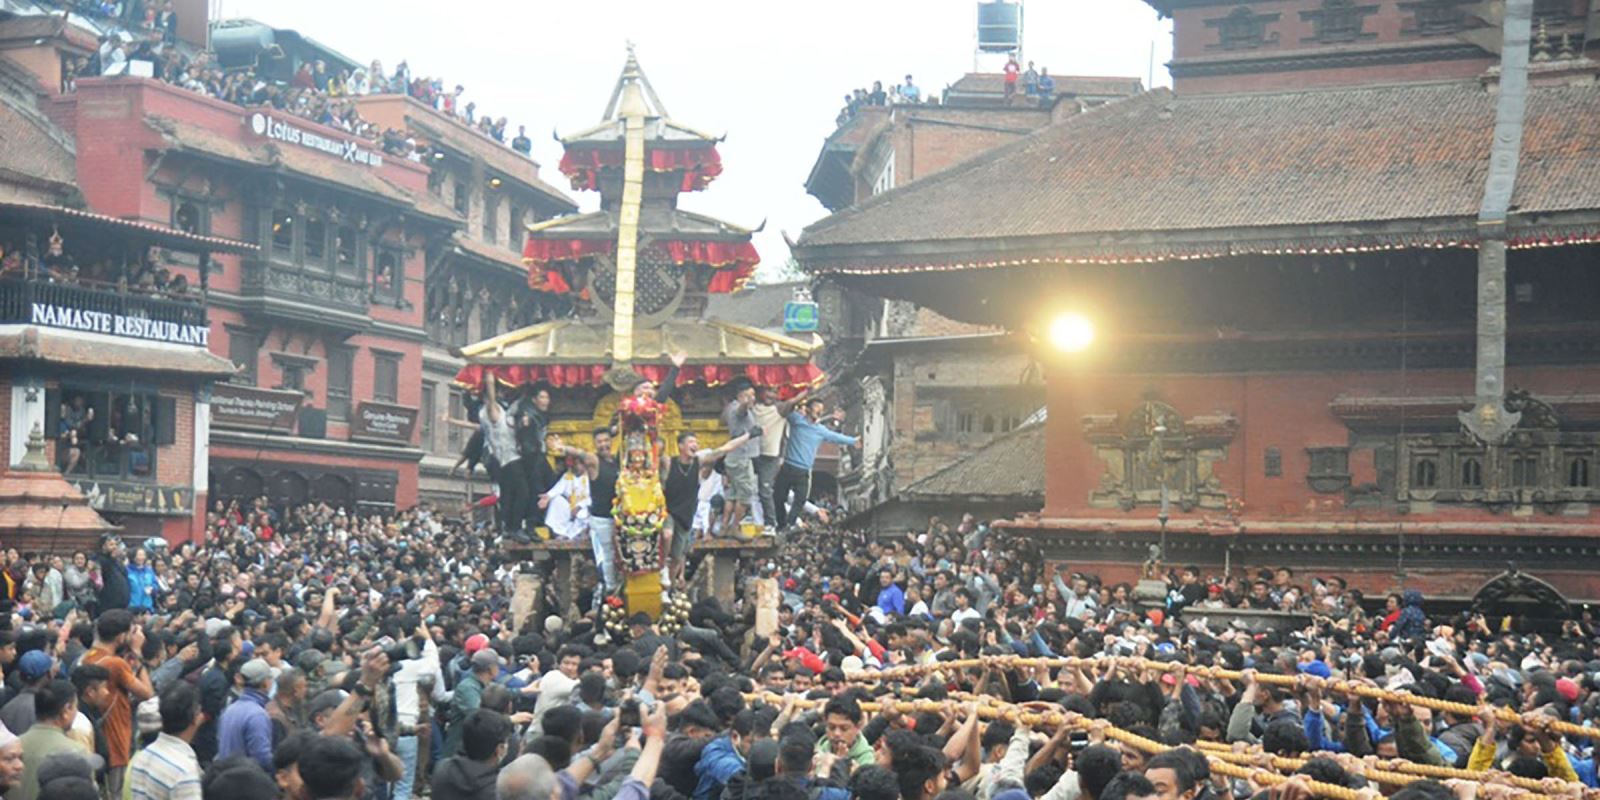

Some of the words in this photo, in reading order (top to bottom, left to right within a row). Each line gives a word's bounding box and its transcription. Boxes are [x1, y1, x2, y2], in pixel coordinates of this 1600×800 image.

[266, 115, 300, 145] Lotus
[302, 132, 345, 156] RESTAURANT
[32, 303, 111, 334] NAMASTE
[115, 315, 210, 345] RESTAURANT
